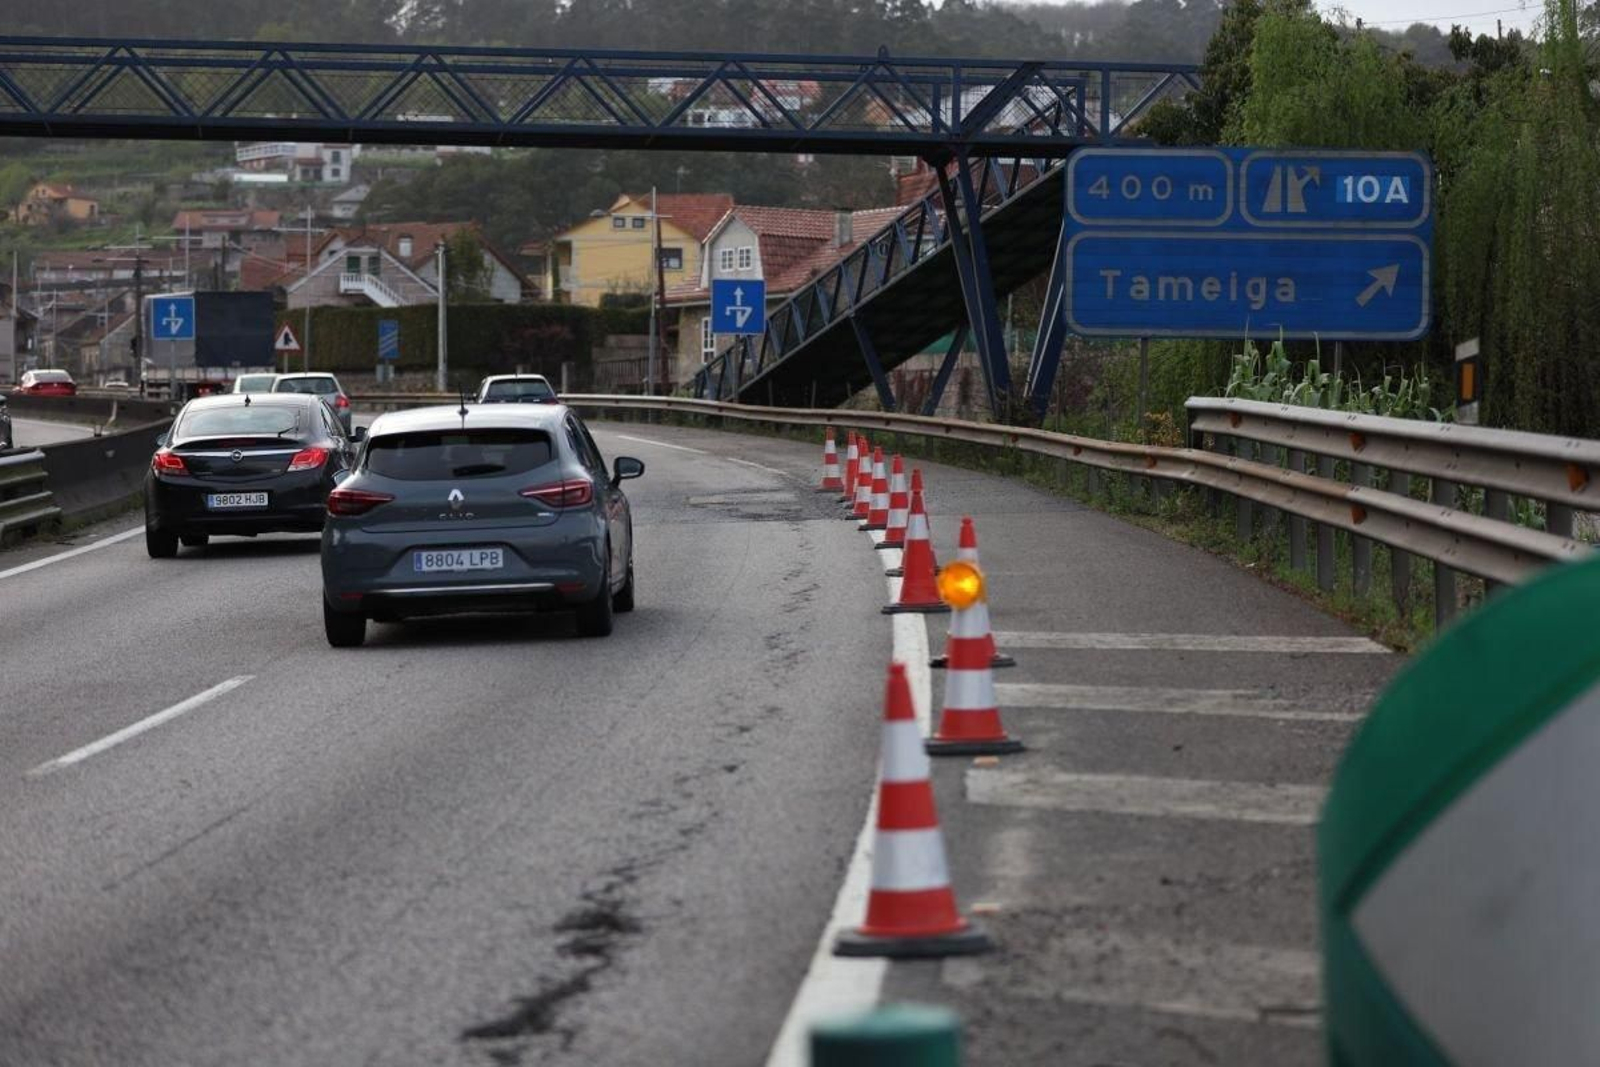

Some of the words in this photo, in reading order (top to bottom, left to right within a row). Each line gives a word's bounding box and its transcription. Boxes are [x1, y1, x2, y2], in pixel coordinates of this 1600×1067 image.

[1087, 174, 1173, 200] 400
[1188, 182, 1214, 201] m
[1342, 174, 1410, 204] 10A
[1099, 269, 1297, 311] Tameiga
[215, 495, 242, 506] 9802
[244, 494, 265, 505] HJB
[425, 552, 465, 568] 8804
[469, 550, 500, 567] LPB
